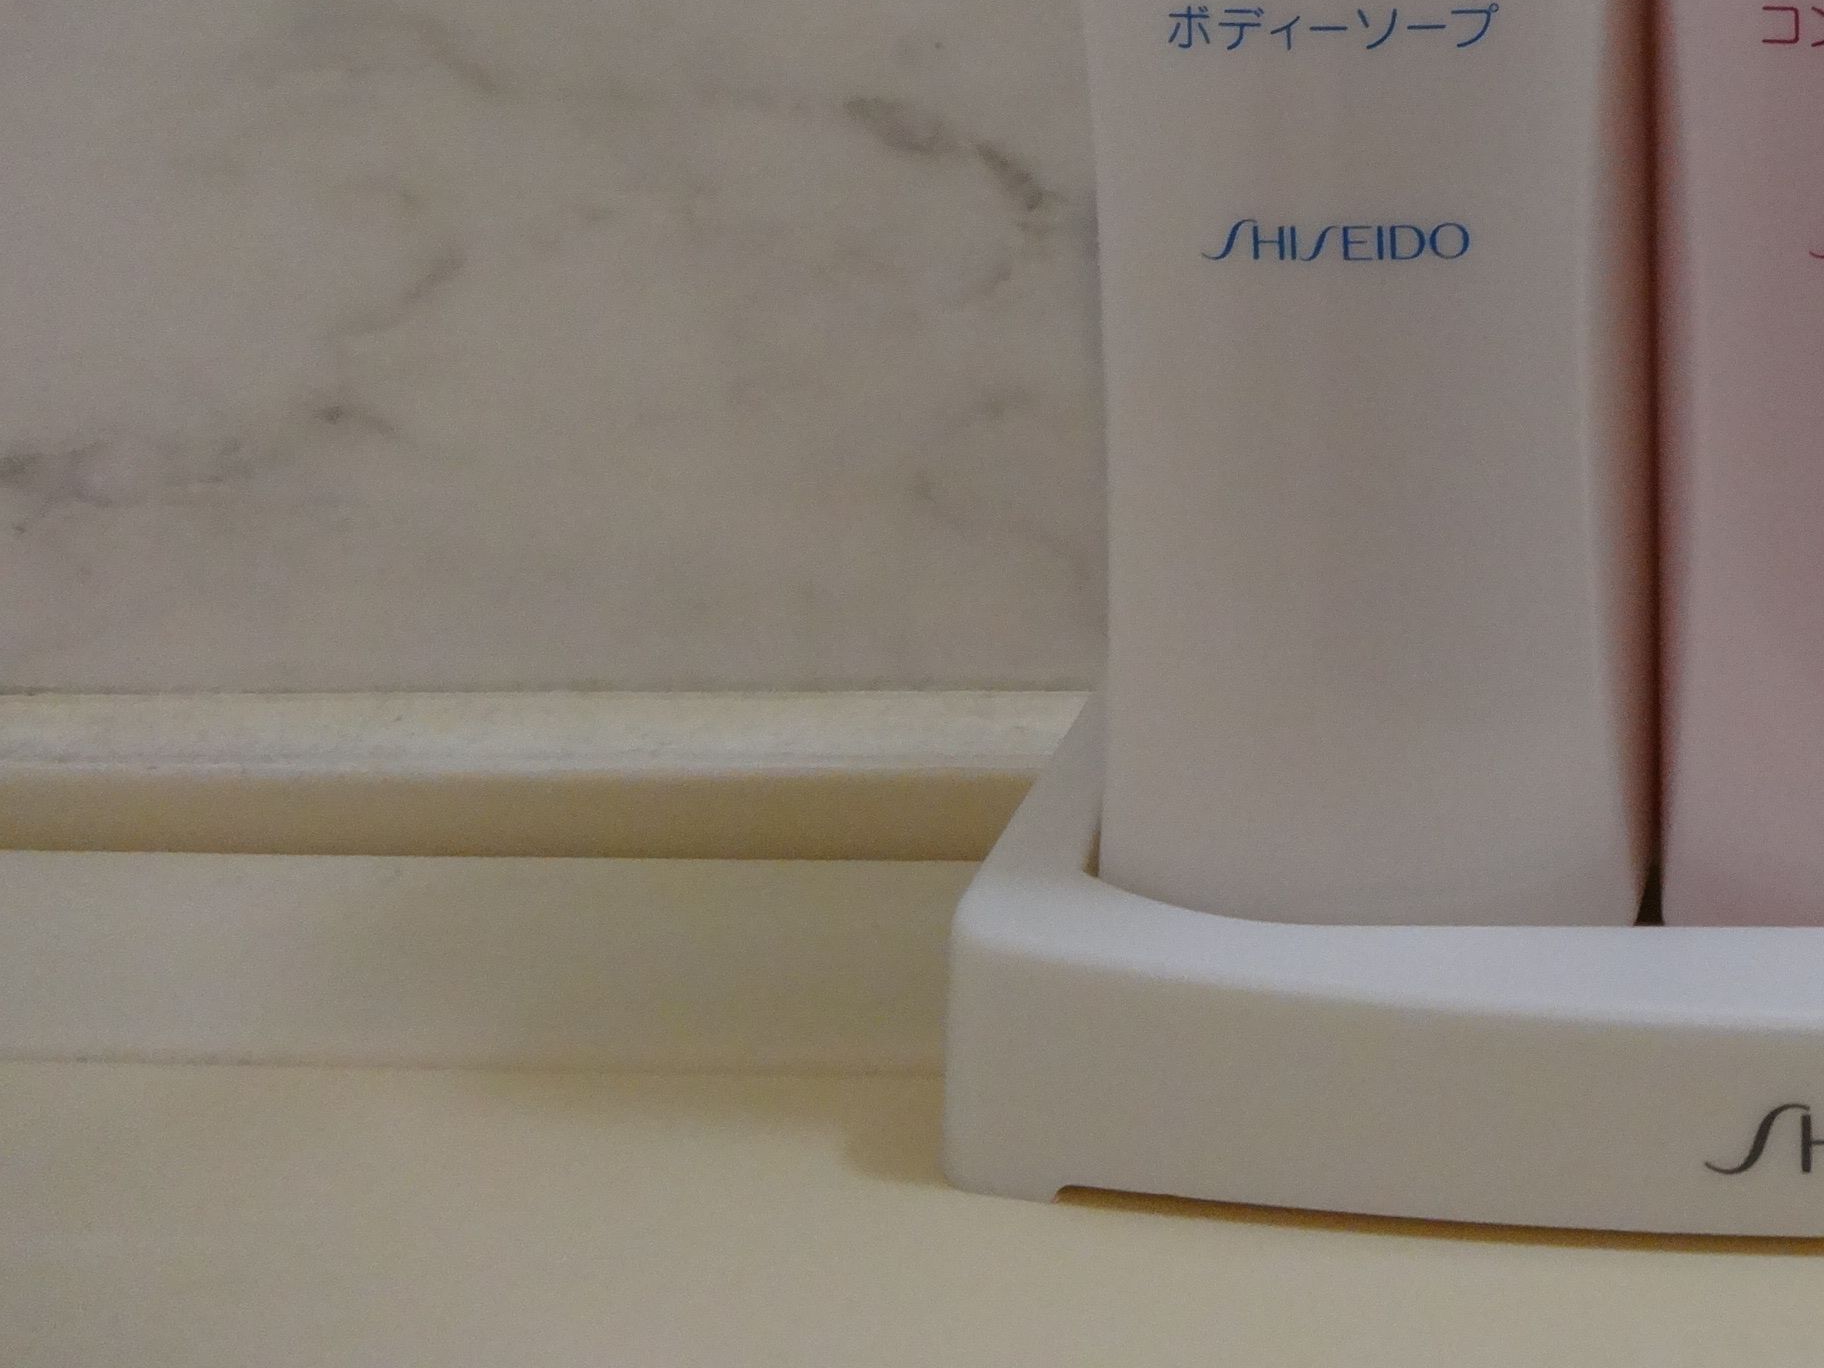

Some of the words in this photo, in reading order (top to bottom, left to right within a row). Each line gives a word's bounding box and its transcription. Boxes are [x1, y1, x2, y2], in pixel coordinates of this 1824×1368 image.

[1167, 2, 1500, 51] ボディーソープ
[1200, 218, 1471, 262] SHISEIDO
